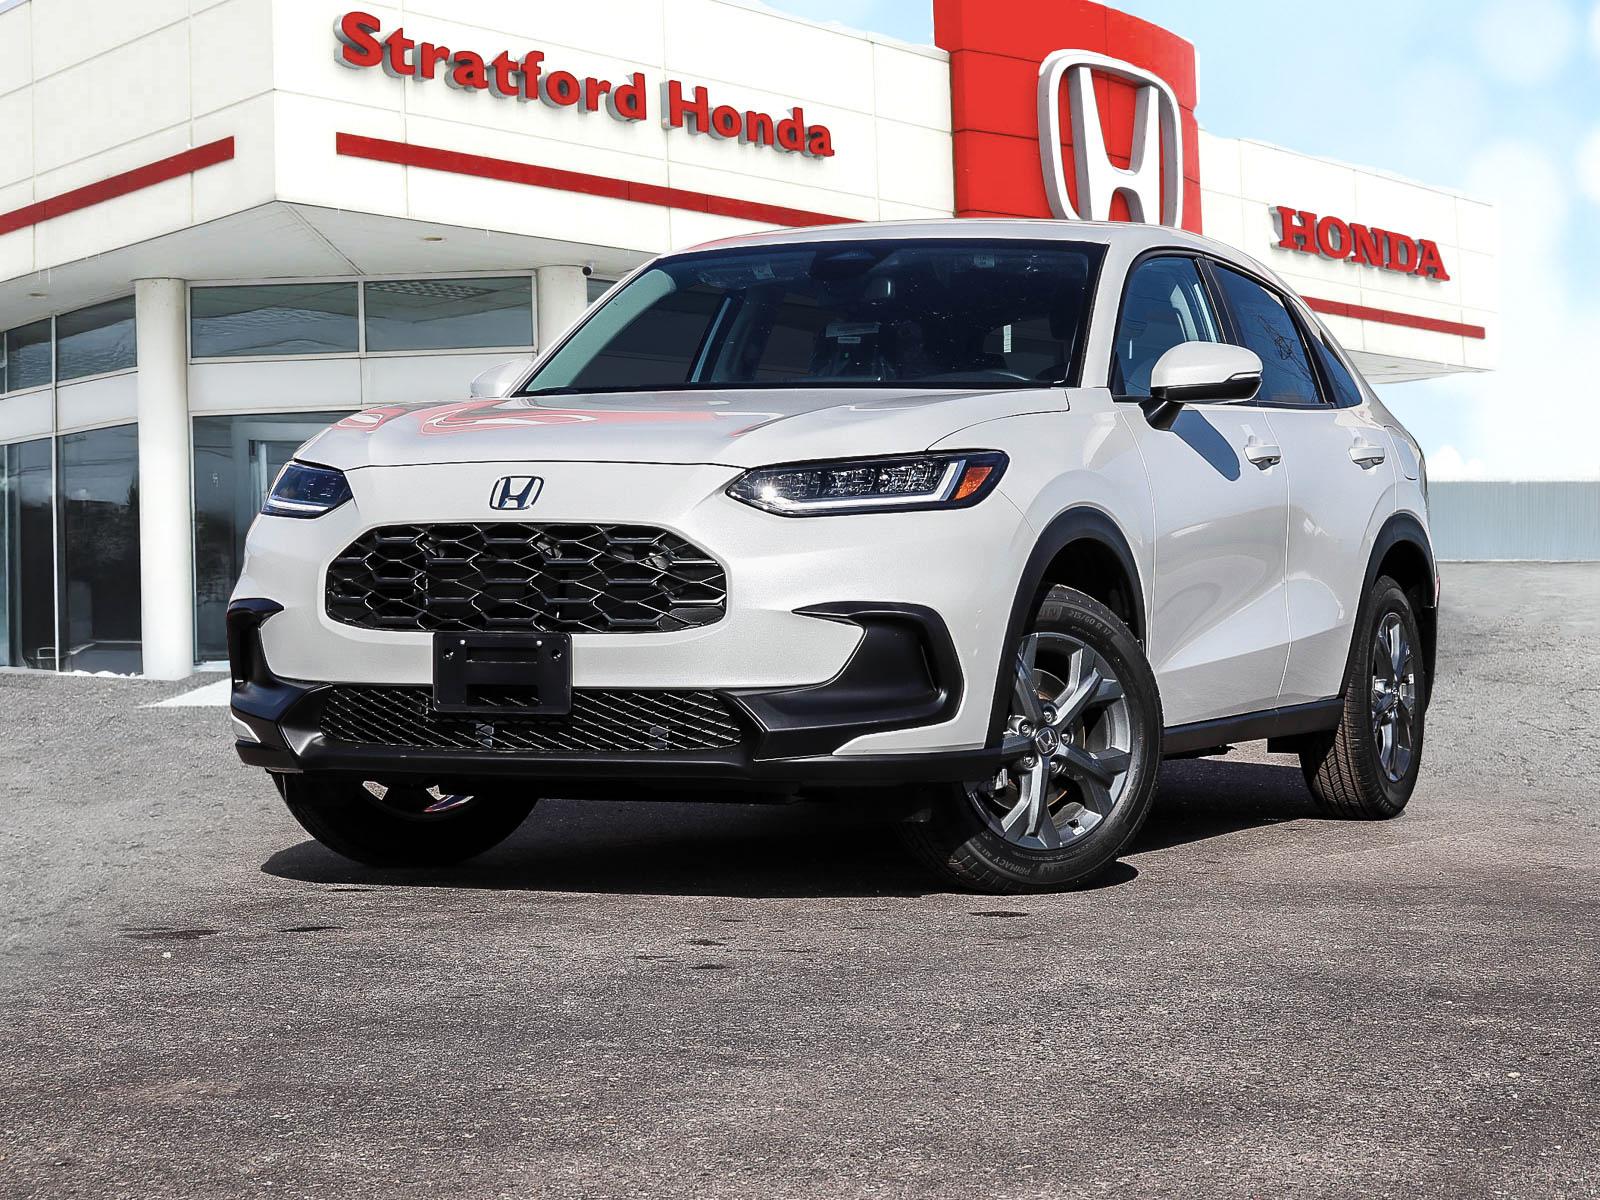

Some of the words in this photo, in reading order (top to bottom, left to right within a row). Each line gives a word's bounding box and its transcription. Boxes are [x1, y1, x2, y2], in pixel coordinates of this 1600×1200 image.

[336, 11, 647, 122] Stratford
[664, 79, 835, 157] Honda
[1271, 205, 1450, 281] HONDA
[992, 856, 1031, 876] PRIMACY
